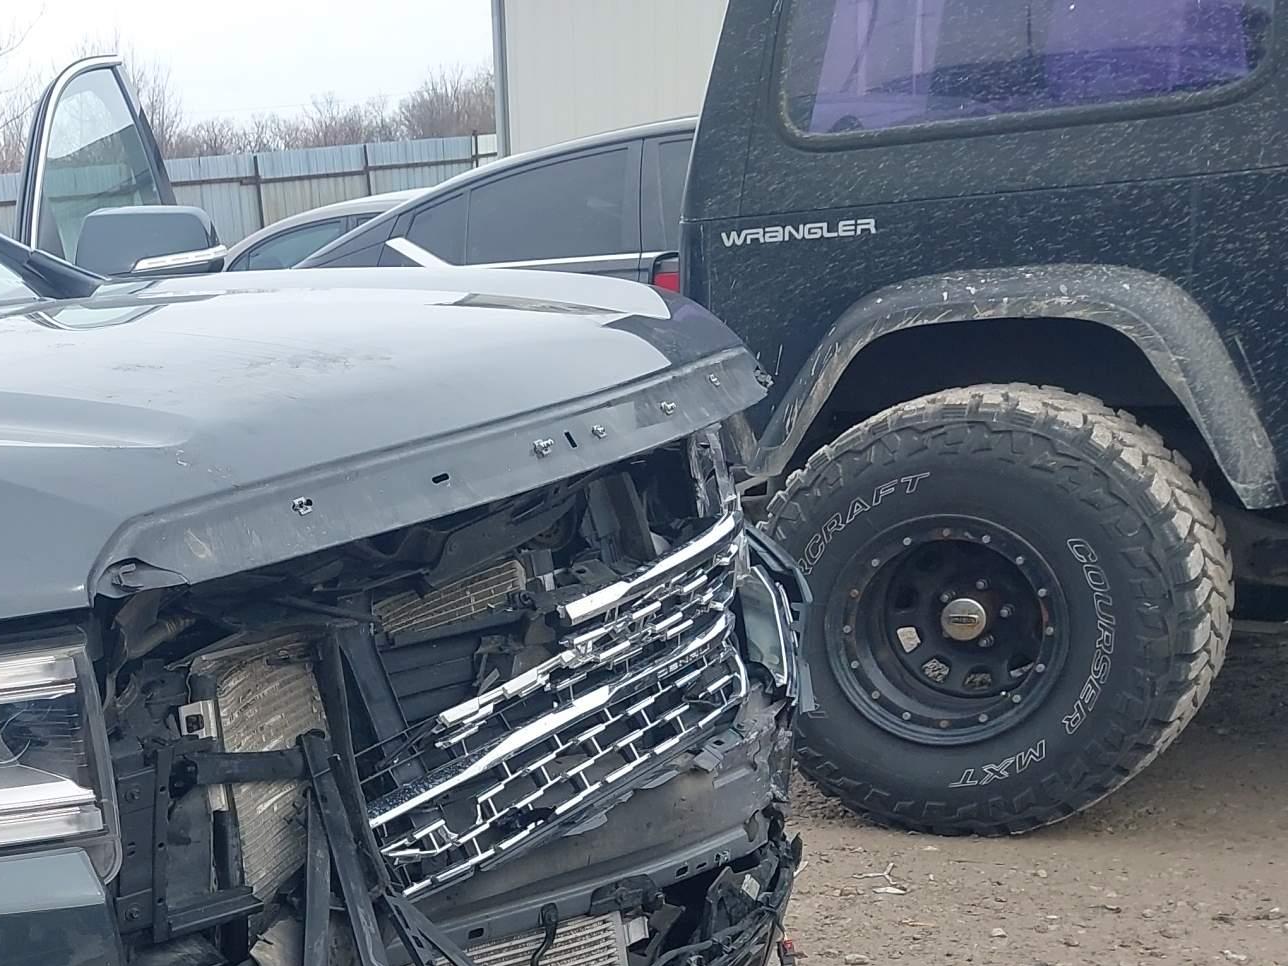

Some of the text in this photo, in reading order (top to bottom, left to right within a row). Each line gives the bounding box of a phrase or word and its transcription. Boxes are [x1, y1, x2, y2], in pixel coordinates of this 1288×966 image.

[720, 218, 877, 248] WRANGLER
[1062, 537, 1117, 736] COURSER
[948, 739, 1047, 788] MXT
